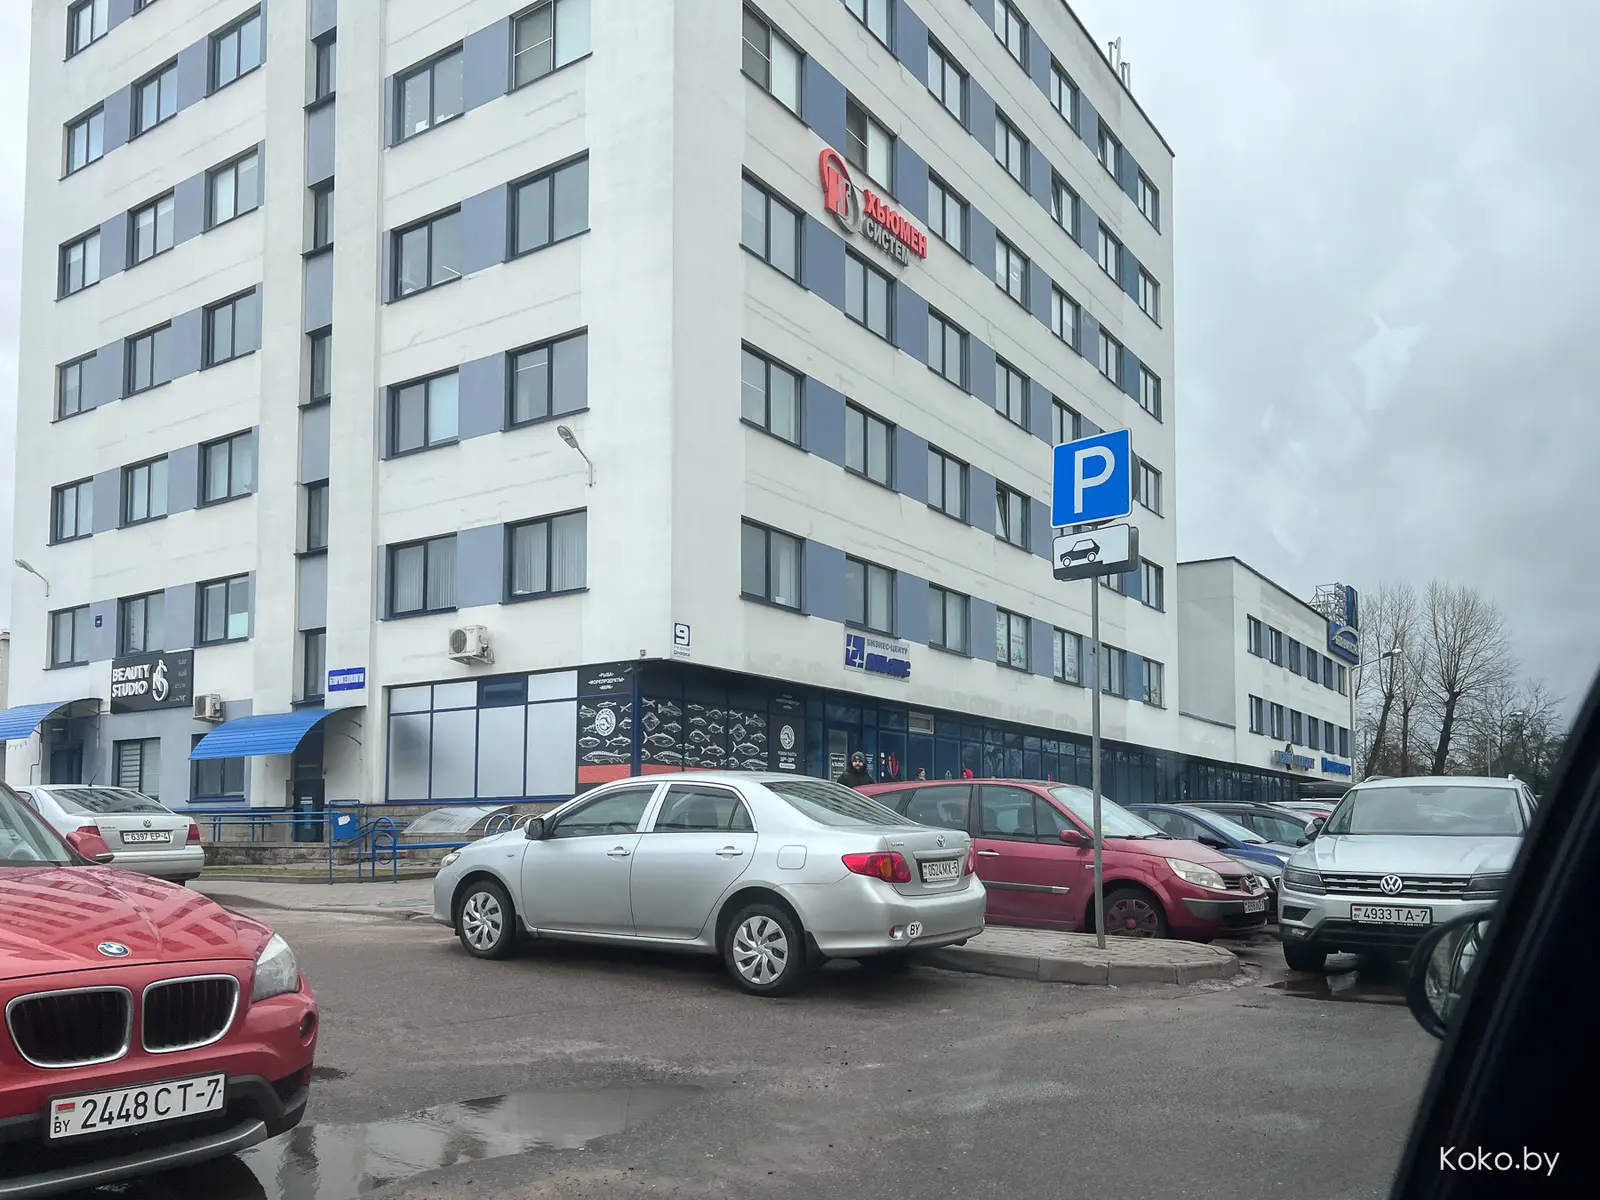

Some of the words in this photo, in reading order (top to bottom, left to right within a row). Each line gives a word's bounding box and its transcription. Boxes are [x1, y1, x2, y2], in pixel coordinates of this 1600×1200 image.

[864, 189, 927, 259] ХЬЮМЕН
[865, 219, 910, 267] СИСТЕМ
[1074, 445, 1115, 514] P
[675, 623, 689, 645] 9
[866, 639, 908, 655] БИЗНЕС-ЦЕНТР
[112, 664, 152, 682] BEAUTY
[111, 681, 149, 697] STUDIO
[130, 832, 148, 841] 6397
[909, 924, 921, 935] BY
[54, 1120, 70, 1134] BY
